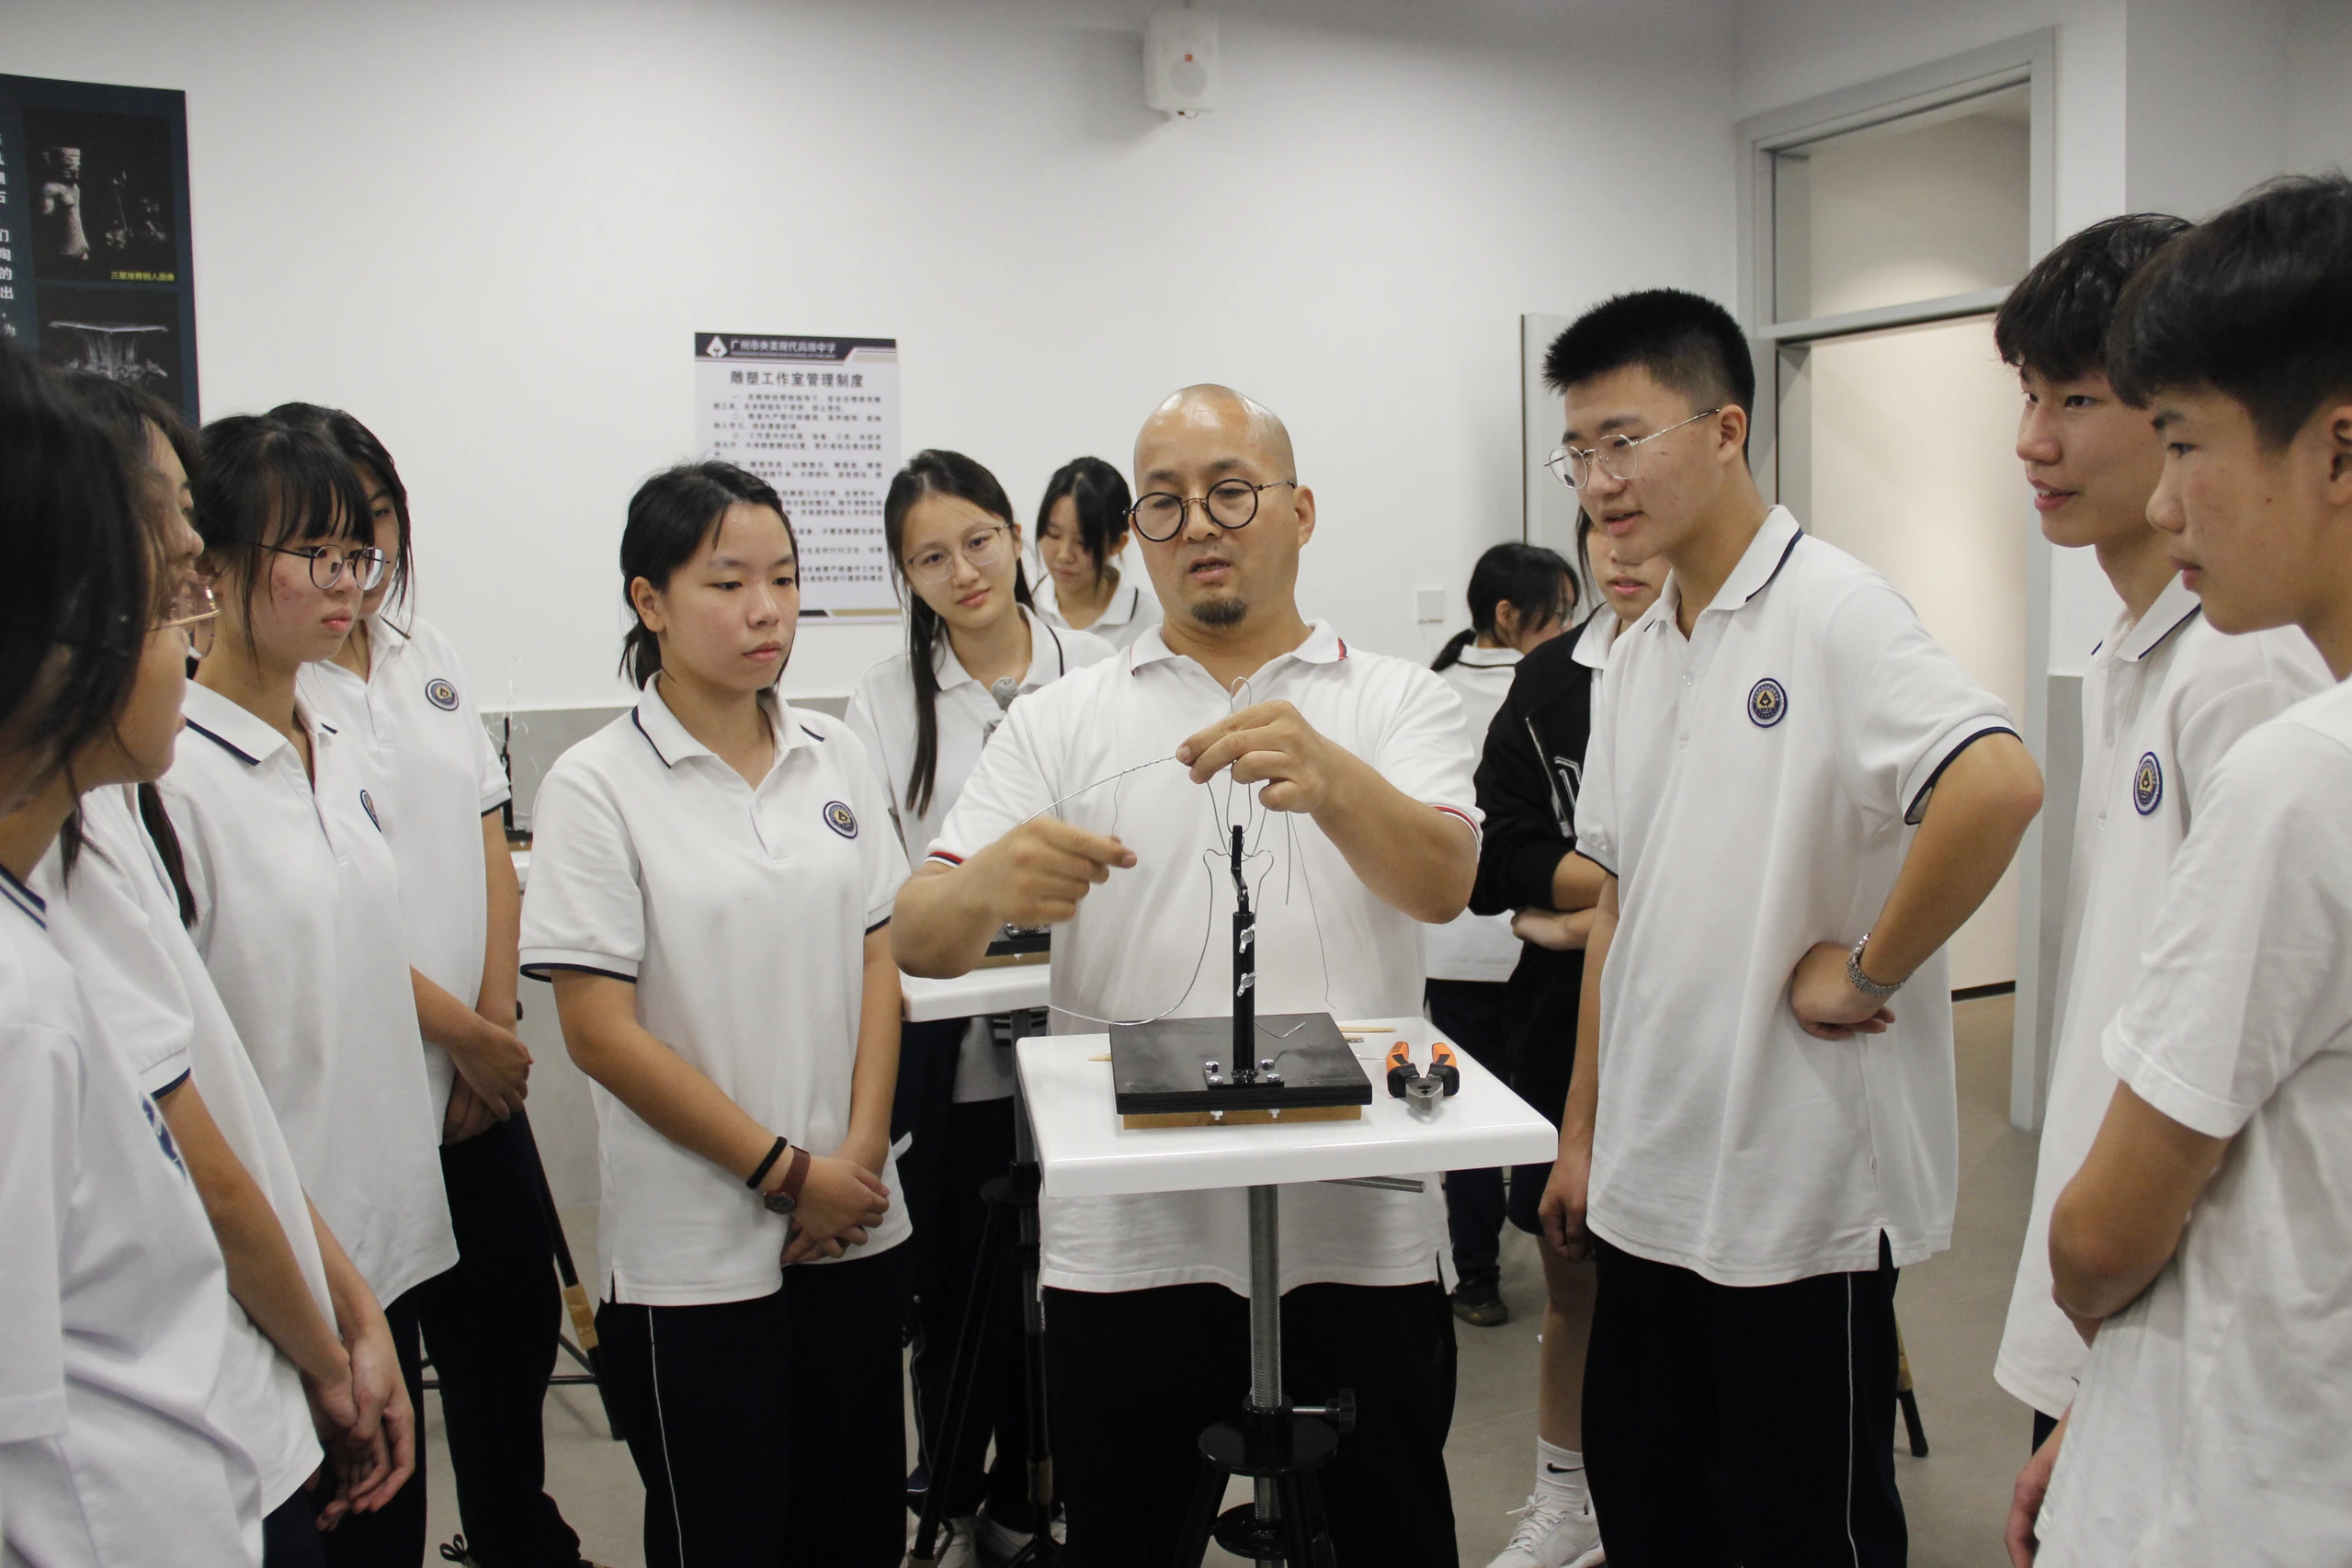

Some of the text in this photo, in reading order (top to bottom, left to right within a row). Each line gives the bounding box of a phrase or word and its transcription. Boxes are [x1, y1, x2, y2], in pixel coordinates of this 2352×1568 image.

[0, 286, 14, 300] 出
[731, 370, 864, 389] 雕塑工作室管理制度
